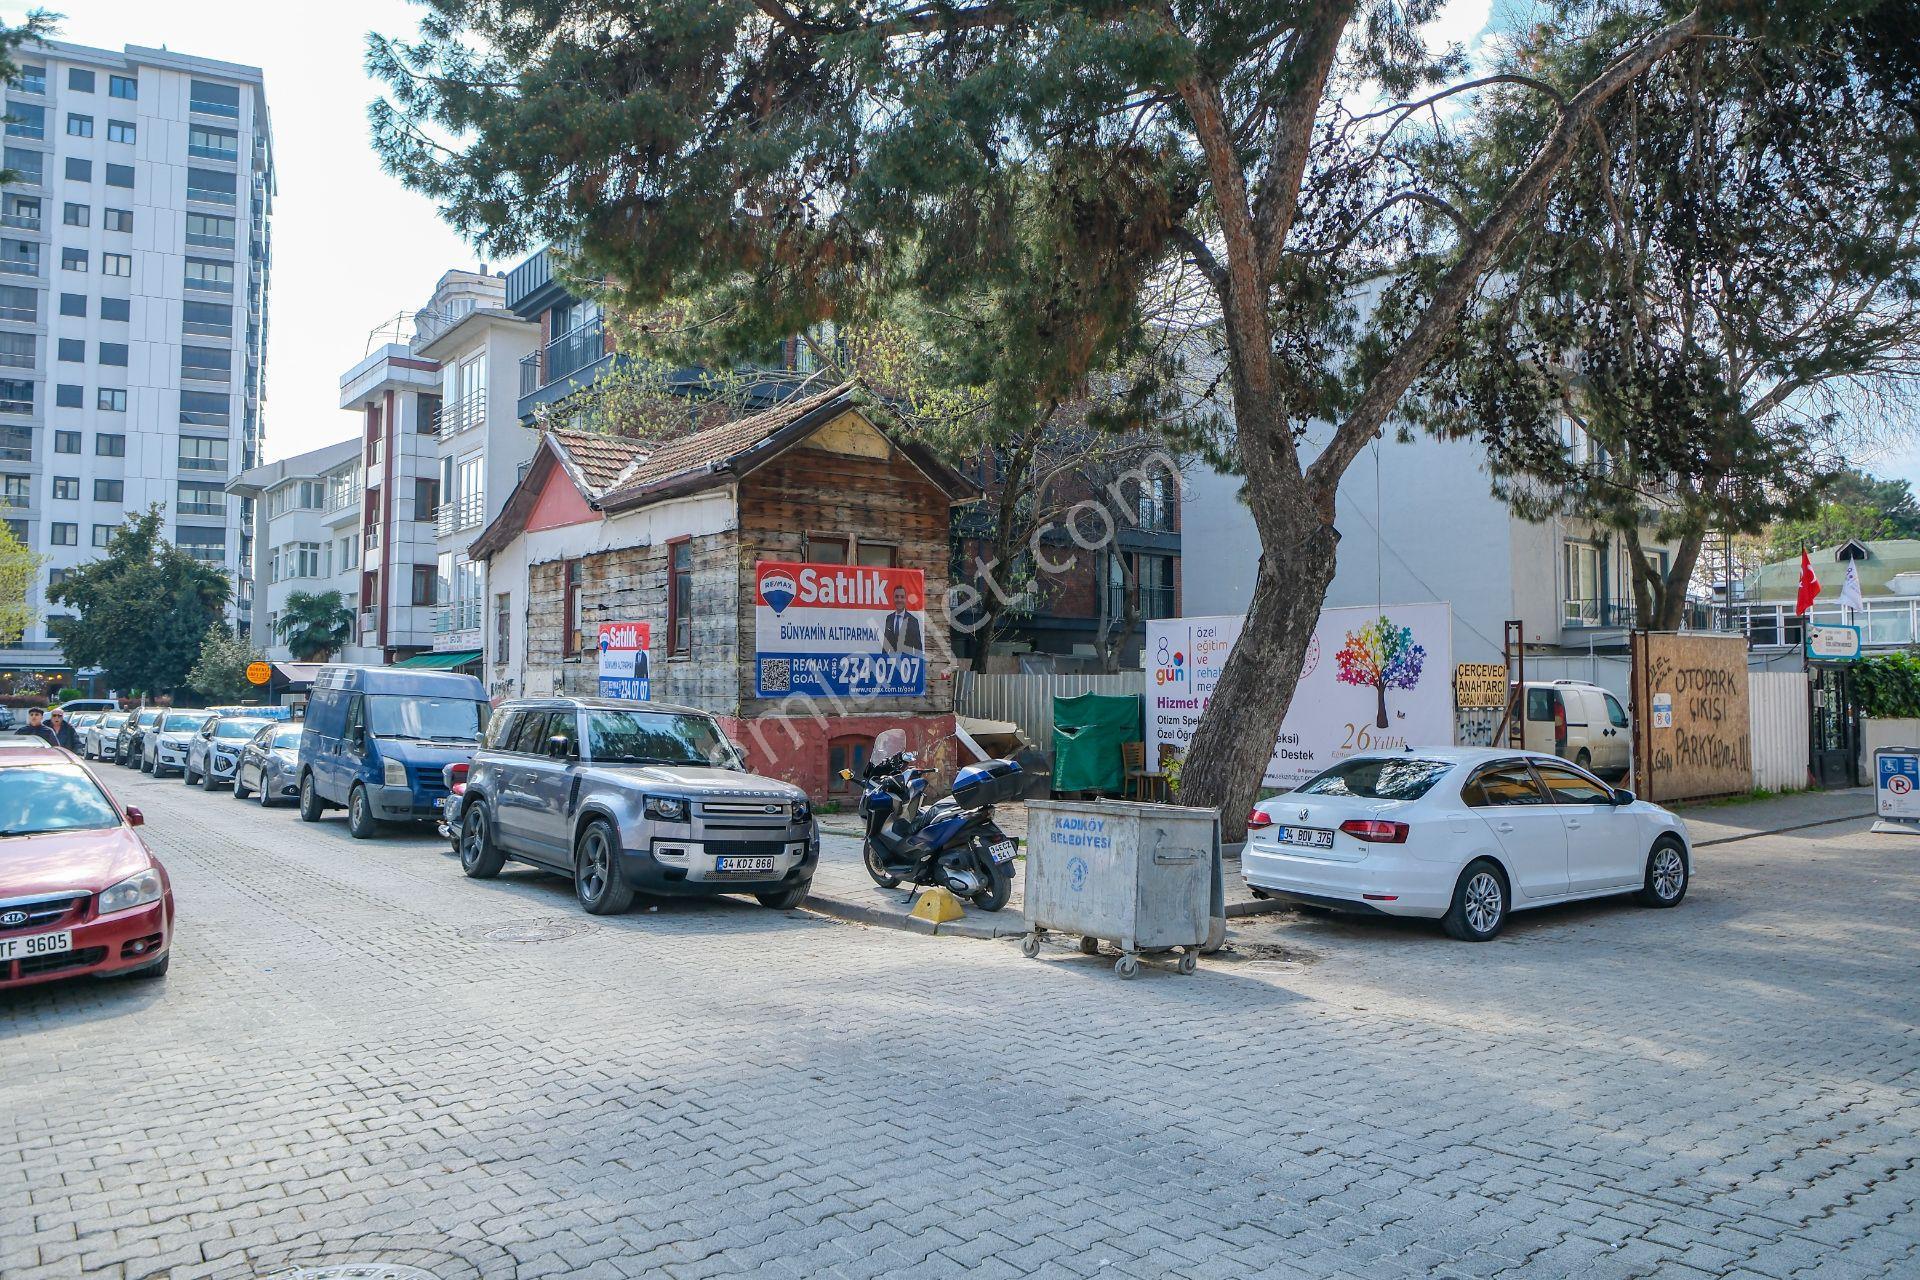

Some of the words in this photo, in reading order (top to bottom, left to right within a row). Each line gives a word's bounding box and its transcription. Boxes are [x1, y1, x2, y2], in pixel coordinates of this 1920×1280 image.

[764, 580, 792, 590] RE/MAX
[799, 568, 889, 605] Satılık
[610, 625, 638, 648] Satılık
[780, 622, 826, 641] BÜNYAMİN
[828, 626, 880, 642] ALTIPARMAK
[1196, 626, 1217, 638] özel
[1196, 640, 1228, 654] eğitim
[792, 658, 830, 672] RE/MAX
[1196, 656, 1208, 665] ve
[838, 656, 871, 684] 234
[875, 657, 897, 684] 07
[900, 657, 920, 684] 07
[1156, 664, 1184, 686] gün
[792, 674, 820, 684] GOAL
[1675, 668, 1736, 695] OTOPARK
[1458, 680, 1505, 693] ANAHTARCI
[1157, 697, 1199, 709] Hizmet
[1157, 715, 1180, 725] Otizm
[1689, 697, 1727, 729] ÇIKIŞI
[1157, 727, 1175, 739] Özel
[1276, 733, 1299, 747] eksi)
[1341, 722, 1372, 751] 26
[1281, 749, 1314, 760] Destek
[702, 788, 780, 797] DEFENDER
[1055, 816, 1105, 833] KADIKÖY
[1050, 832, 1112, 849] BELEDİYESİ
[1284, 828, 1294, 840] 34
[1316, 831, 1332, 844] 376
[722, 858, 734, 869] 34
[736, 858, 754, 869] KDZ
[3, 913, 24, 922] KIA
[26, 933, 67, 954] 9605
